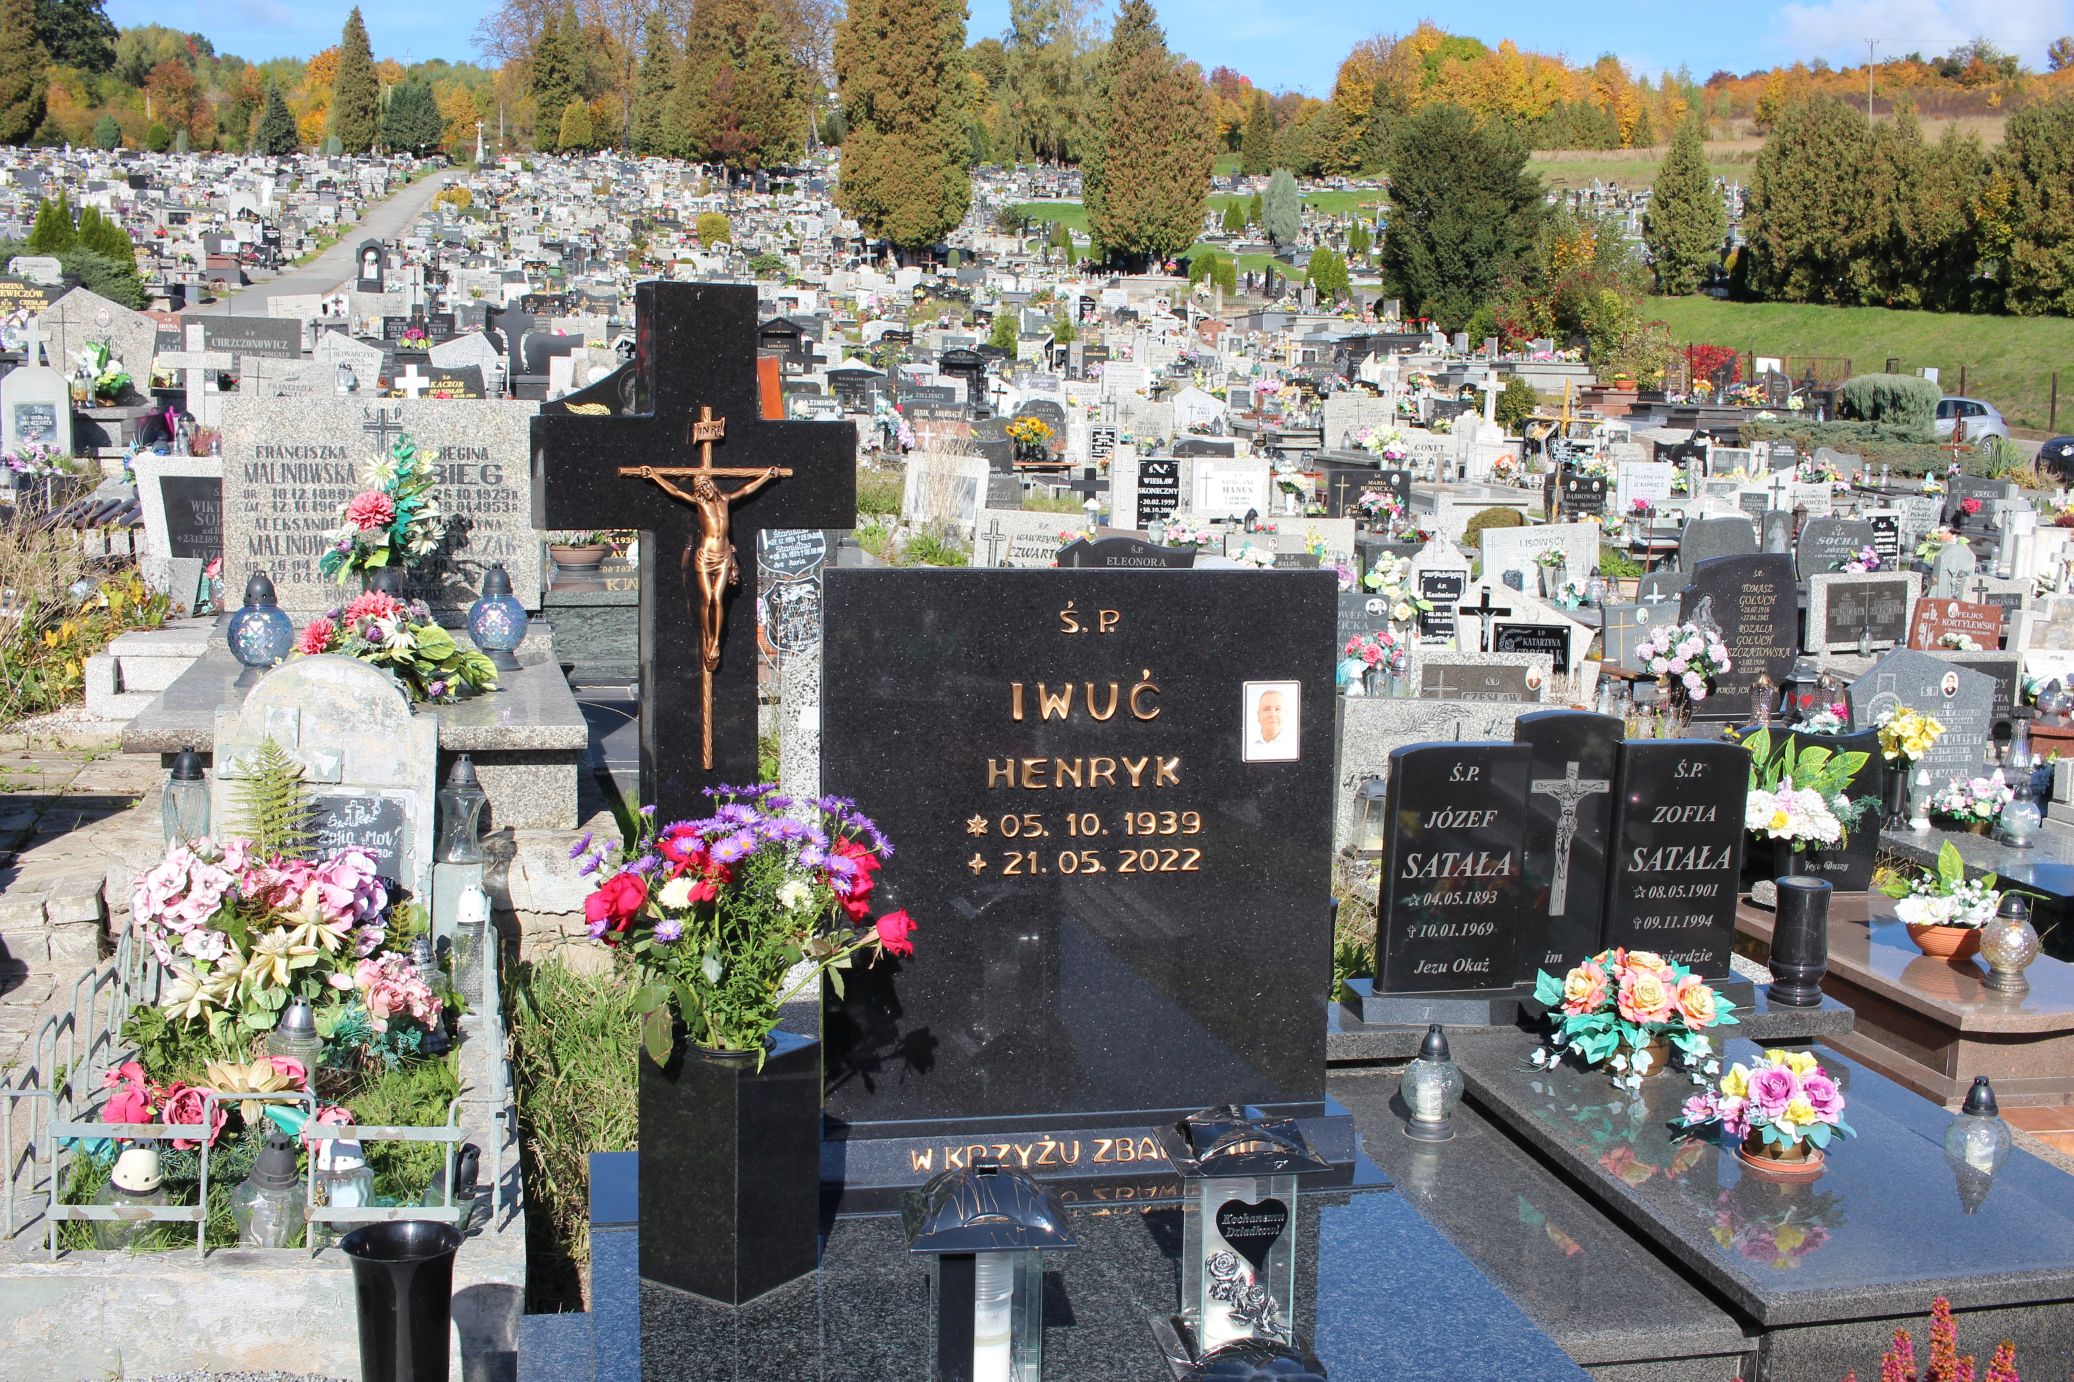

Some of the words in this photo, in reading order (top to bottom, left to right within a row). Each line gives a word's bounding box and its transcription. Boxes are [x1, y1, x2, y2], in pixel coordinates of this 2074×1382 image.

[212, 338, 288, 350] CHRZCZONOWICZ
[267, 384, 314, 392] FRANCISZEK
[700, 425, 721, 436] INRI
[255, 446, 347, 459] FRANCISZKA
[439, 447, 489, 460] REGINA
[244, 463, 356, 484] MALINOWSKA
[1222, 486, 1253, 494] HANUS
[254, 518, 344, 531] ALEKSANDE
[1520, 537, 1565, 547] LISOWSCY
[1816, 536, 1859, 545] SOCHA
[1106, 557, 1167, 567] ELEONORA
[1742, 584, 1774, 593] TOMASZ
[1739, 595, 1777, 607] GOŁUCH
[1958, 612, 1984, 620] FELIKS
[1739, 625, 1773, 634] ROZALIA
[1942, 618, 1995, 631] KORTYLEWSKI
[1522, 638, 1561, 647] KATARZYNA
[1736, 636, 1775, 647] GOŁUCH
[1010, 669, 1161, 722] IWUĆ
[987, 756, 1181, 789] HENRYK
[1449, 762, 1480, 781] Ś.P.
[1674, 759, 1703, 778] Ś.P.
[1424, 806, 1498, 828] JÓZEF
[1651, 805, 1717, 823] ZOFIA
[1124, 811, 1201, 835] 1939
[318, 829, 356, 847] Zofia
[1118, 848, 1201, 873] 2022
[1402, 851, 1511, 879] SATAŁA
[1627, 845, 1731, 872] SATAŁA
[1423, 890, 1498, 906] 04.05.1893
[1648, 883, 1719, 899] 08.05.1901
[1643, 914, 1714, 929] 09.11.1994
[1418, 922, 1494, 938] 10.01.1969
[1413, 959, 1448, 974] Jezu
[1452, 957, 1490, 973] Okaż
[1544, 950, 1563, 964] im
[911, 1147, 933, 1172] W
